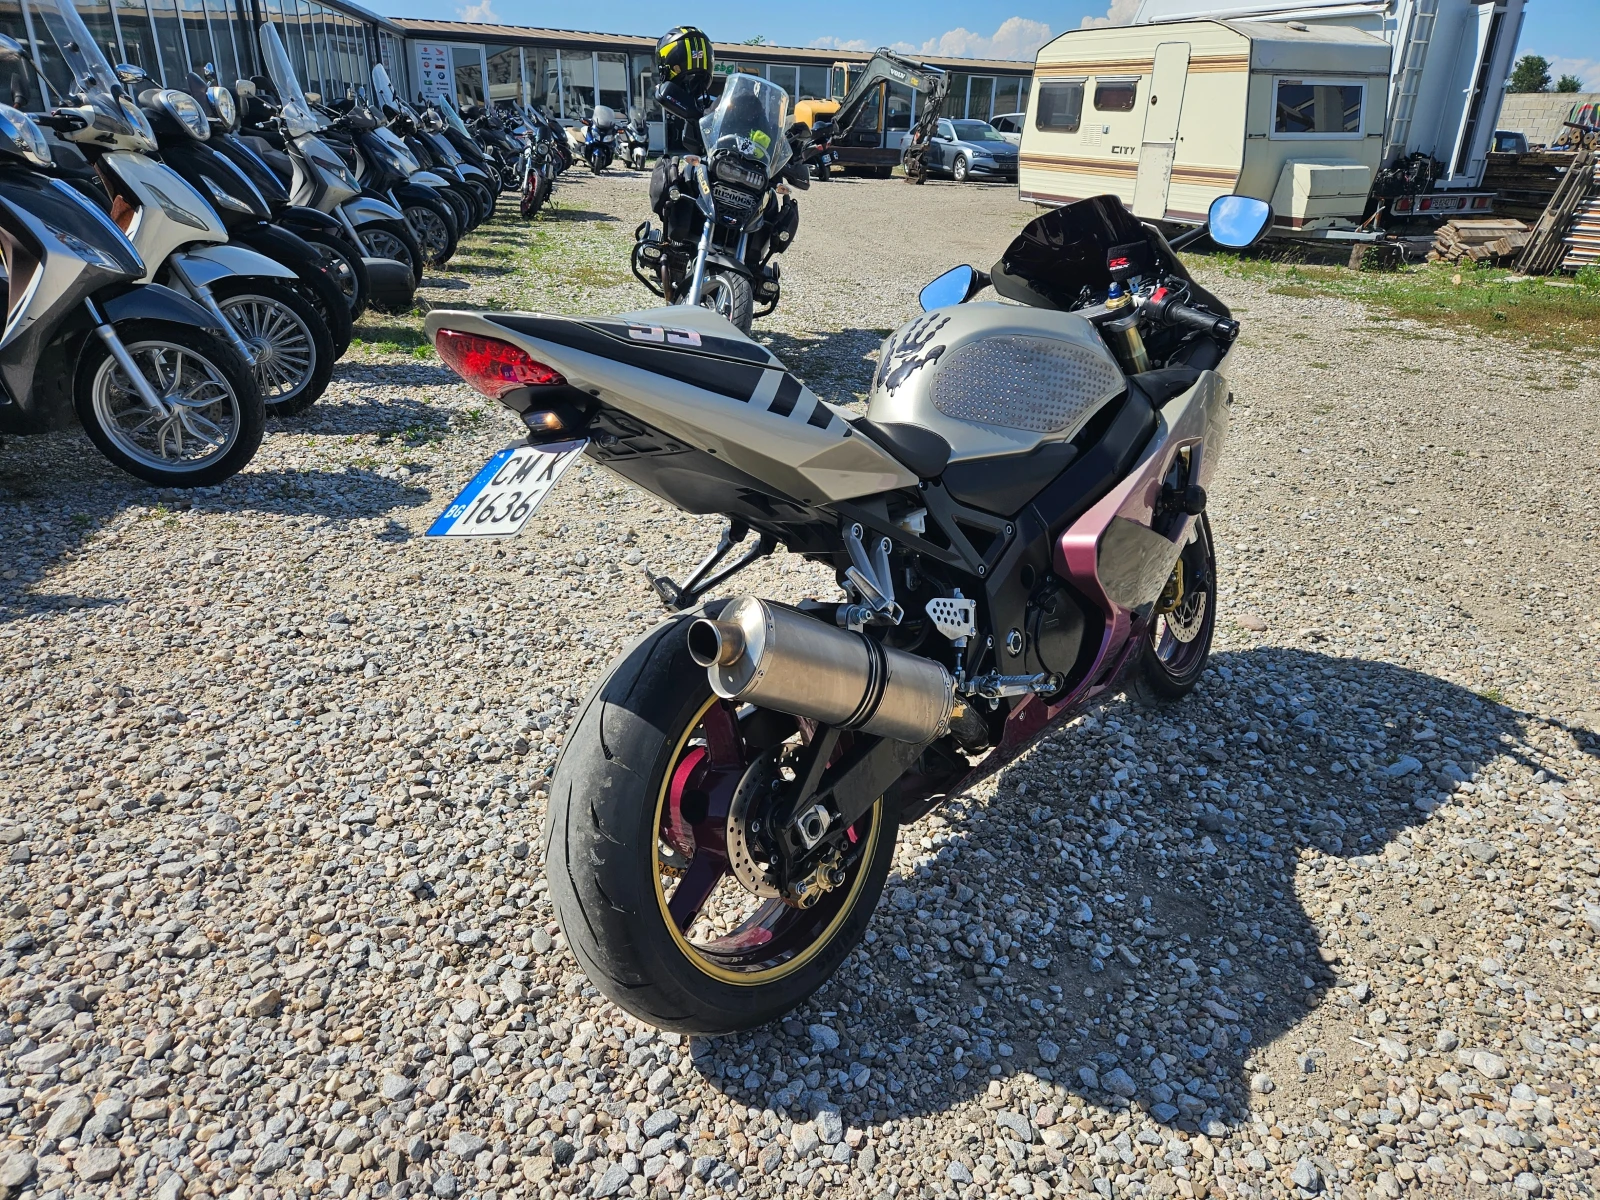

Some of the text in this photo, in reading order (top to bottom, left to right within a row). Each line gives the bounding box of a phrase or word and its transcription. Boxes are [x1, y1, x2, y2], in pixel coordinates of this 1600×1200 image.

[1111, 145, 1136, 155] CITY
[713, 187, 753, 207] R1200GS
[491, 450, 572, 486] CM K
[443, 504, 467, 519] BG
[462, 489, 542, 525] 1636
